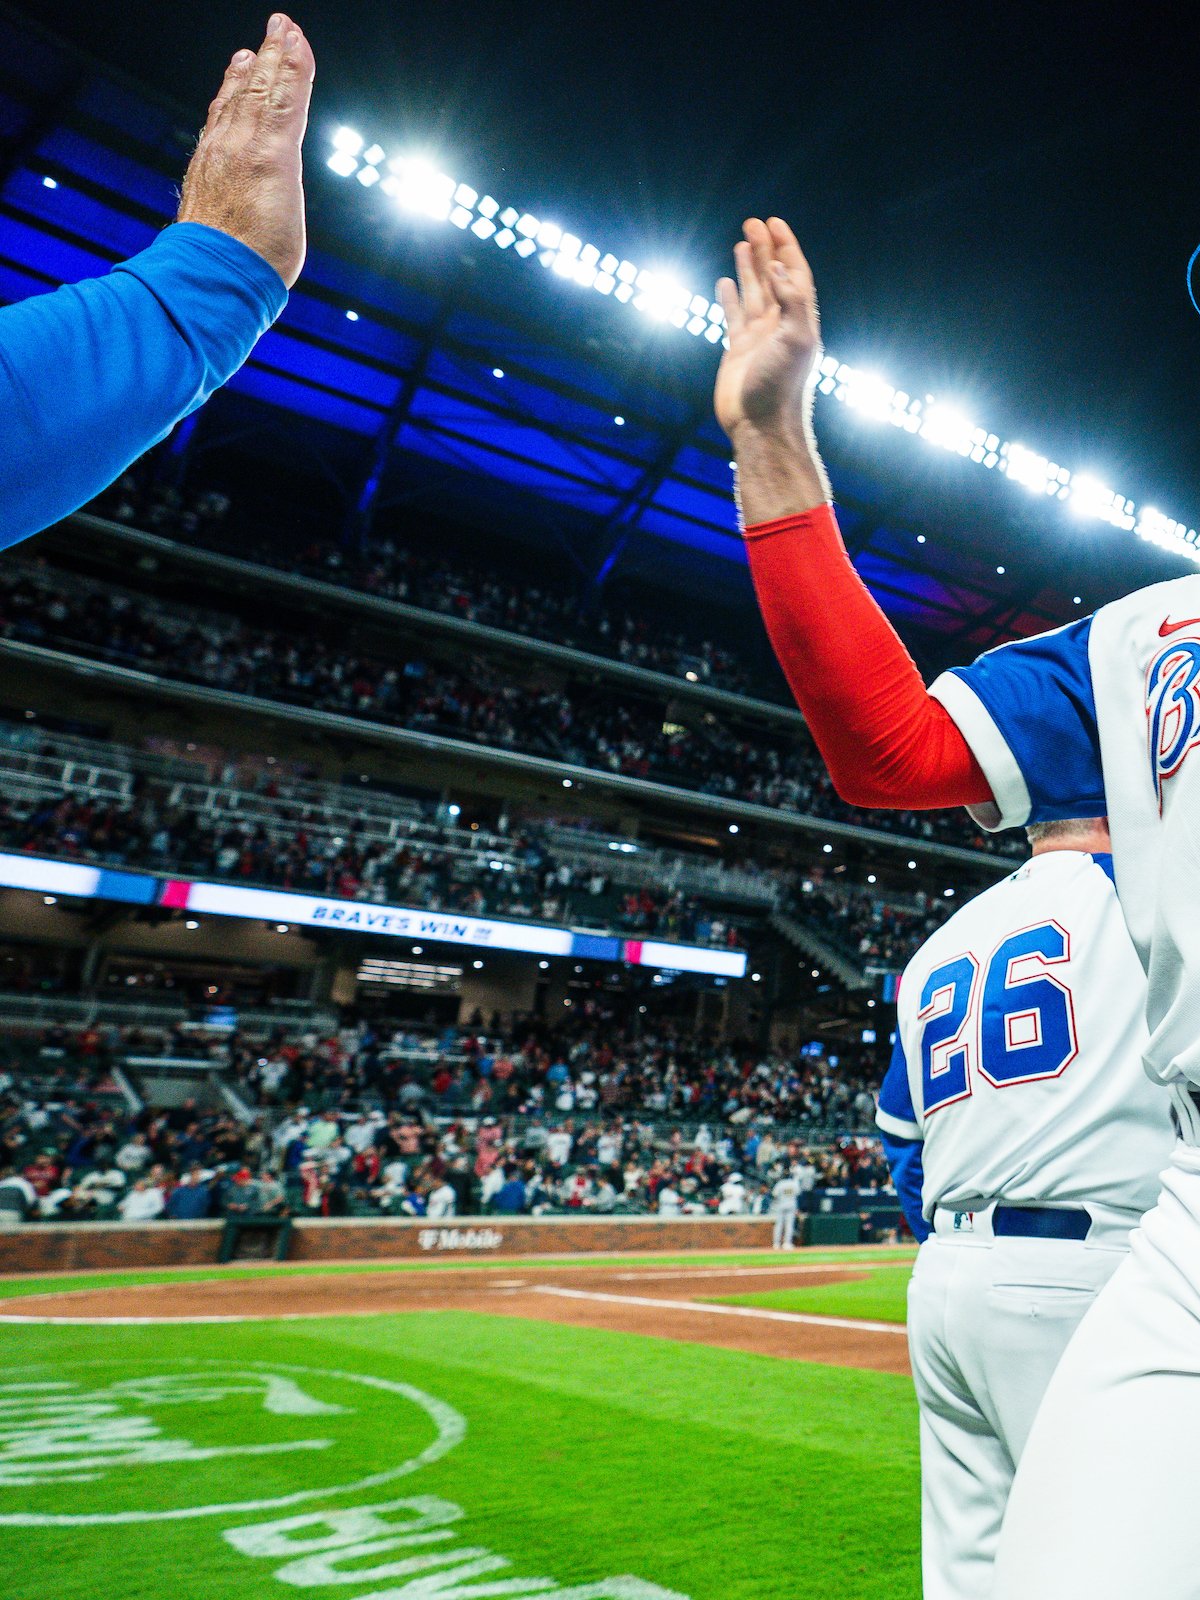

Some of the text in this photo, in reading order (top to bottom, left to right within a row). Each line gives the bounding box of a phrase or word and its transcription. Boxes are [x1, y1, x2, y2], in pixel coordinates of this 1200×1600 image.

[311, 905, 411, 930] BRAVES
[420, 919, 468, 937] WIN
[918, 918, 1079, 1119] 26
